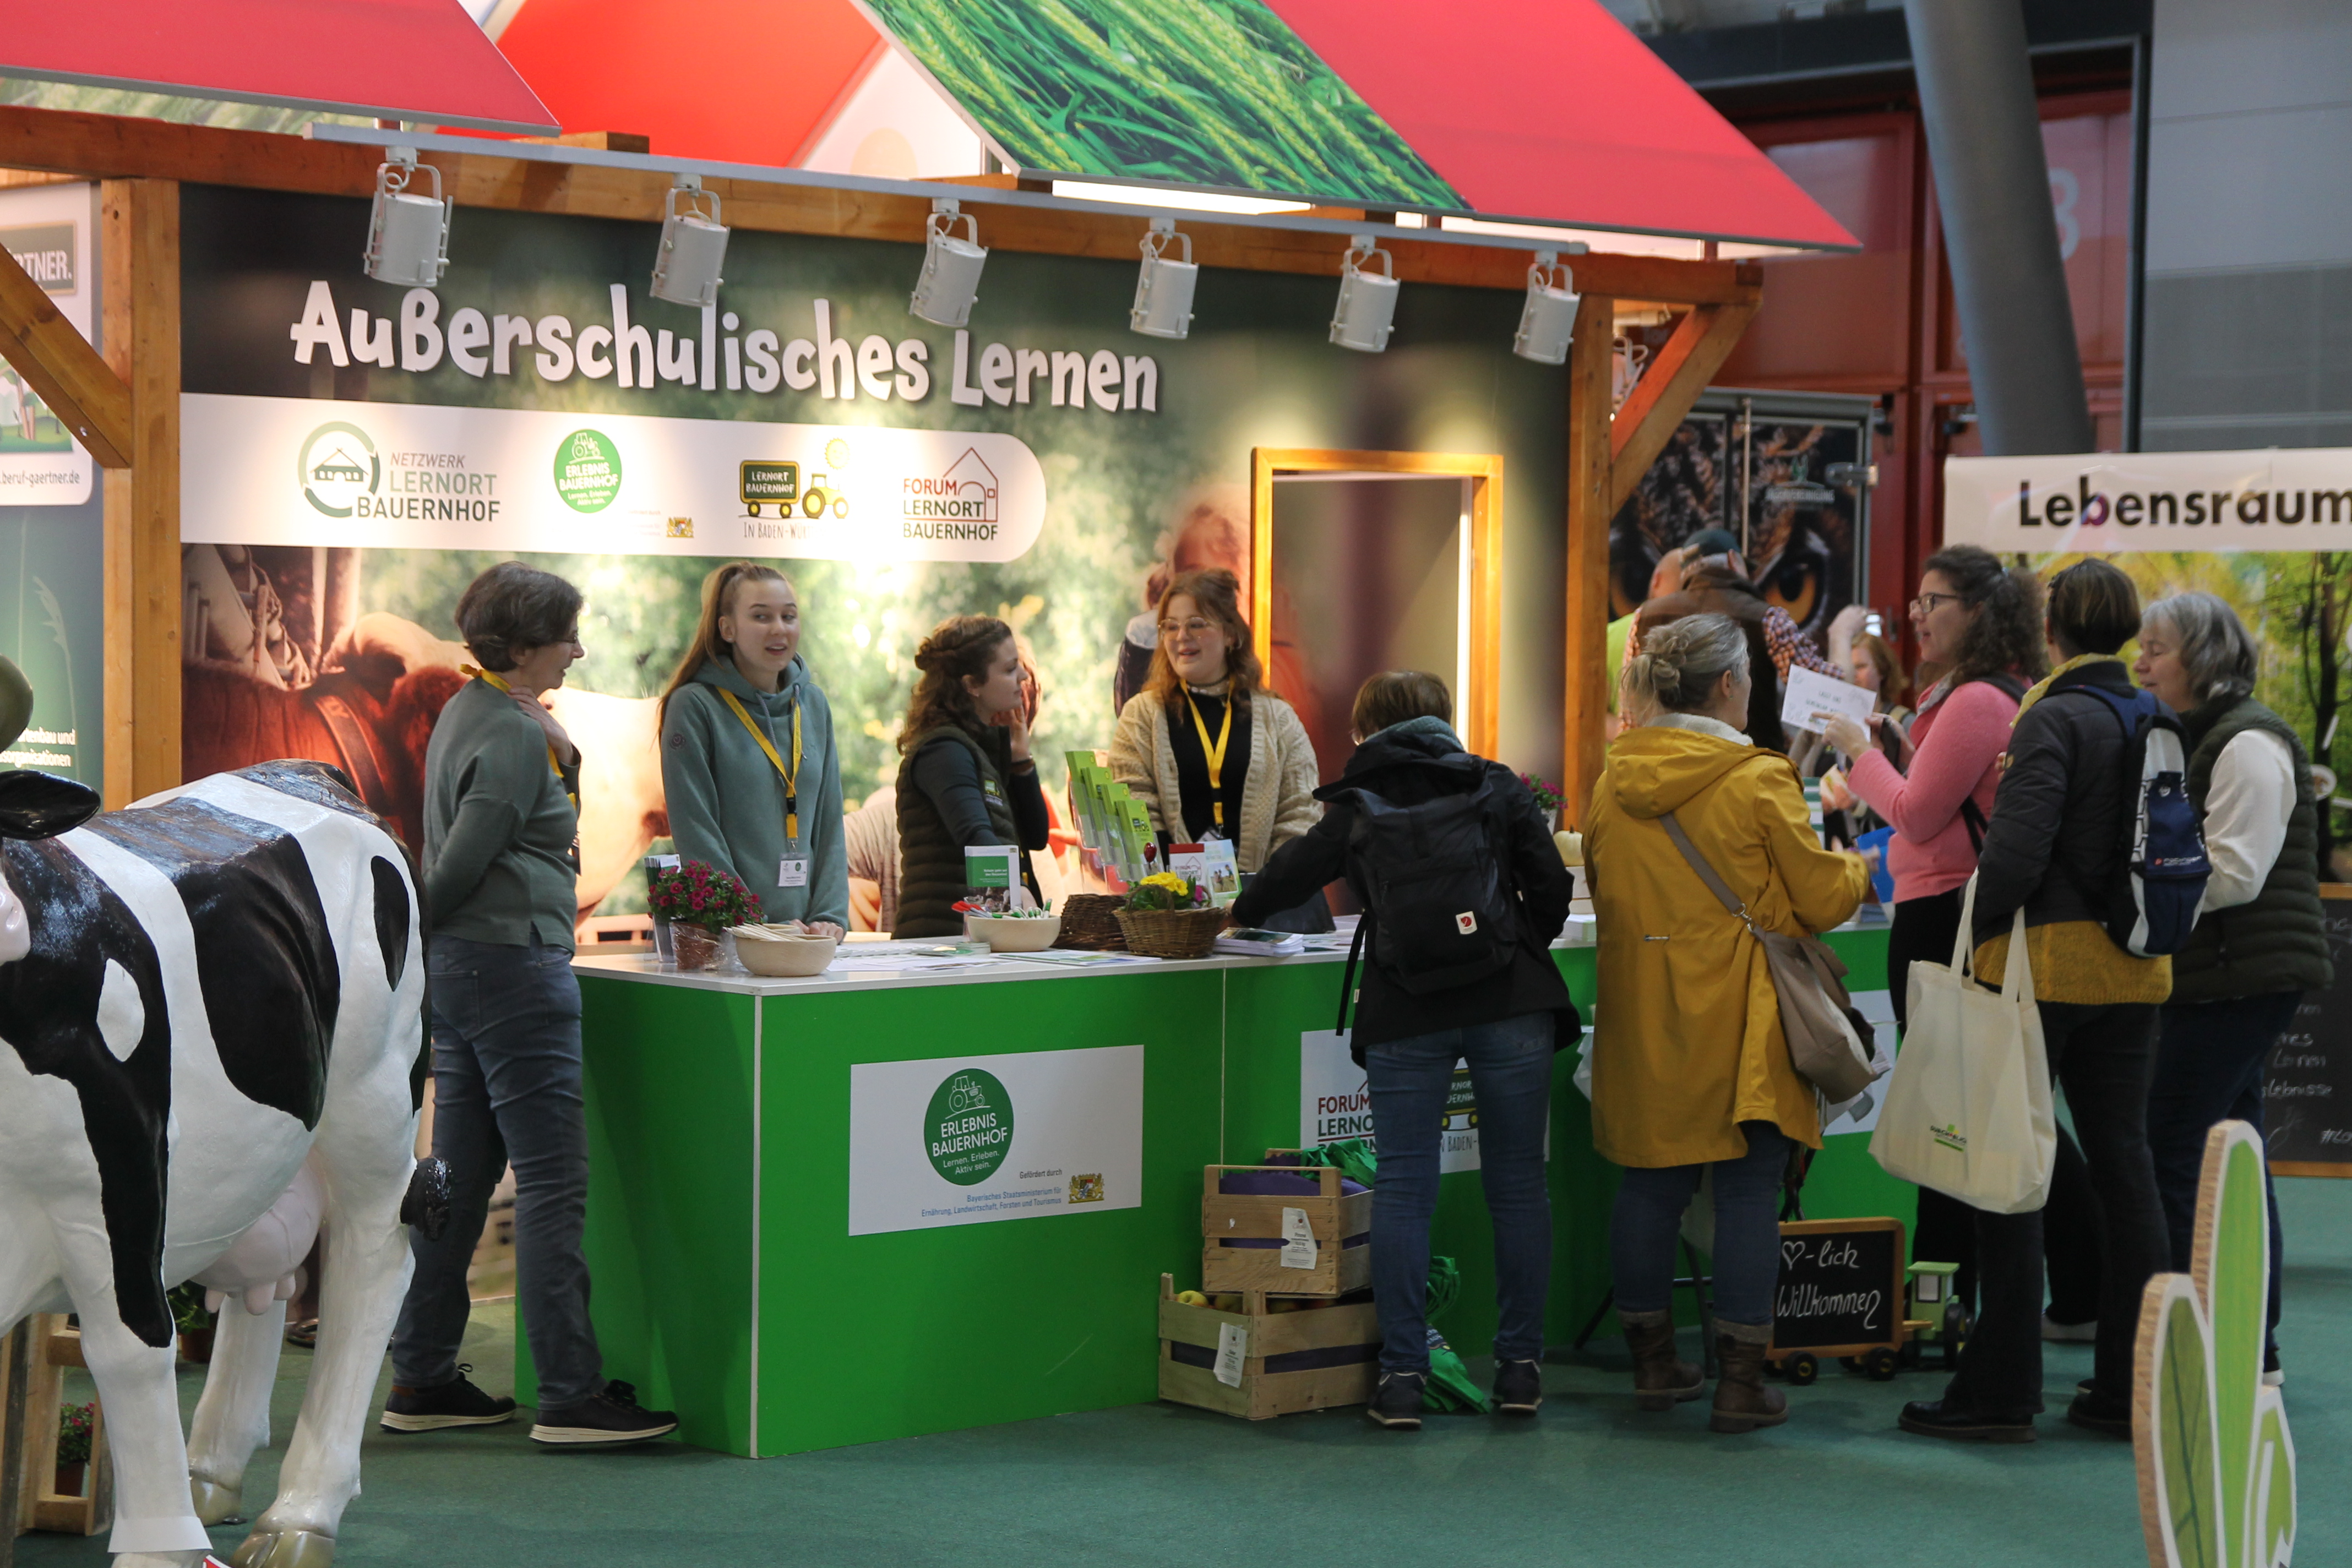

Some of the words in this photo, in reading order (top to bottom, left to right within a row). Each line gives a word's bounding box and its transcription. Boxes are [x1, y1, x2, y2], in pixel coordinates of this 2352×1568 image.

[8, 249, 72, 281] TNER.
[290, 280, 930, 402] Außerschulisches
[951, 329, 1156, 412] Lernen
[390, 452, 466, 469] NETZWERK
[565, 462, 610, 478] ERLEBNIS
[752, 471, 789, 482] LERNORT
[390, 470, 497, 495] LERNORT
[559, 473, 618, 492] BAUERNHOF
[745, 483, 795, 494] BAUERNHOF
[904, 478, 957, 496] FORUM
[357, 496, 500, 521] BAUERNHOF
[904, 499, 984, 517] LERNORT
[2020, 475, 2352, 527] Lebensraum
[903, 522, 998, 540] BAUERNHOF
[58, 728, 76, 745] und
[1318, 1093, 1372, 1115] FORUM
[941, 1112, 997, 1138] ERLEBNIS
[1318, 1114, 1375, 1137] LERNO
[932, 1126, 1008, 1157] BAUERNHOF
[943, 1157, 970, 1168] Lernen.
[971, 1151, 1000, 1162] Erleben.
[955, 1165, 973, 1175] Aktiv
[974, 1161, 991, 1170] sein.
[1020, 1170, 1046, 1179] Gefördert
[1047, 1168, 1063, 1177] durch
[967, 1193, 1001, 1203] Bayerisches
[1003, 1188, 1053, 1199] Staatsministerium
[922, 1208, 952, 1217] Ernährung,
[954, 1203, 998, 1214] Landwirtschaft,
[1000, 1200, 1021, 1209] Forsten
[1034, 1197, 1062, 1206] Tourismus
[1776, 1283, 1881, 1330] Willkommen
